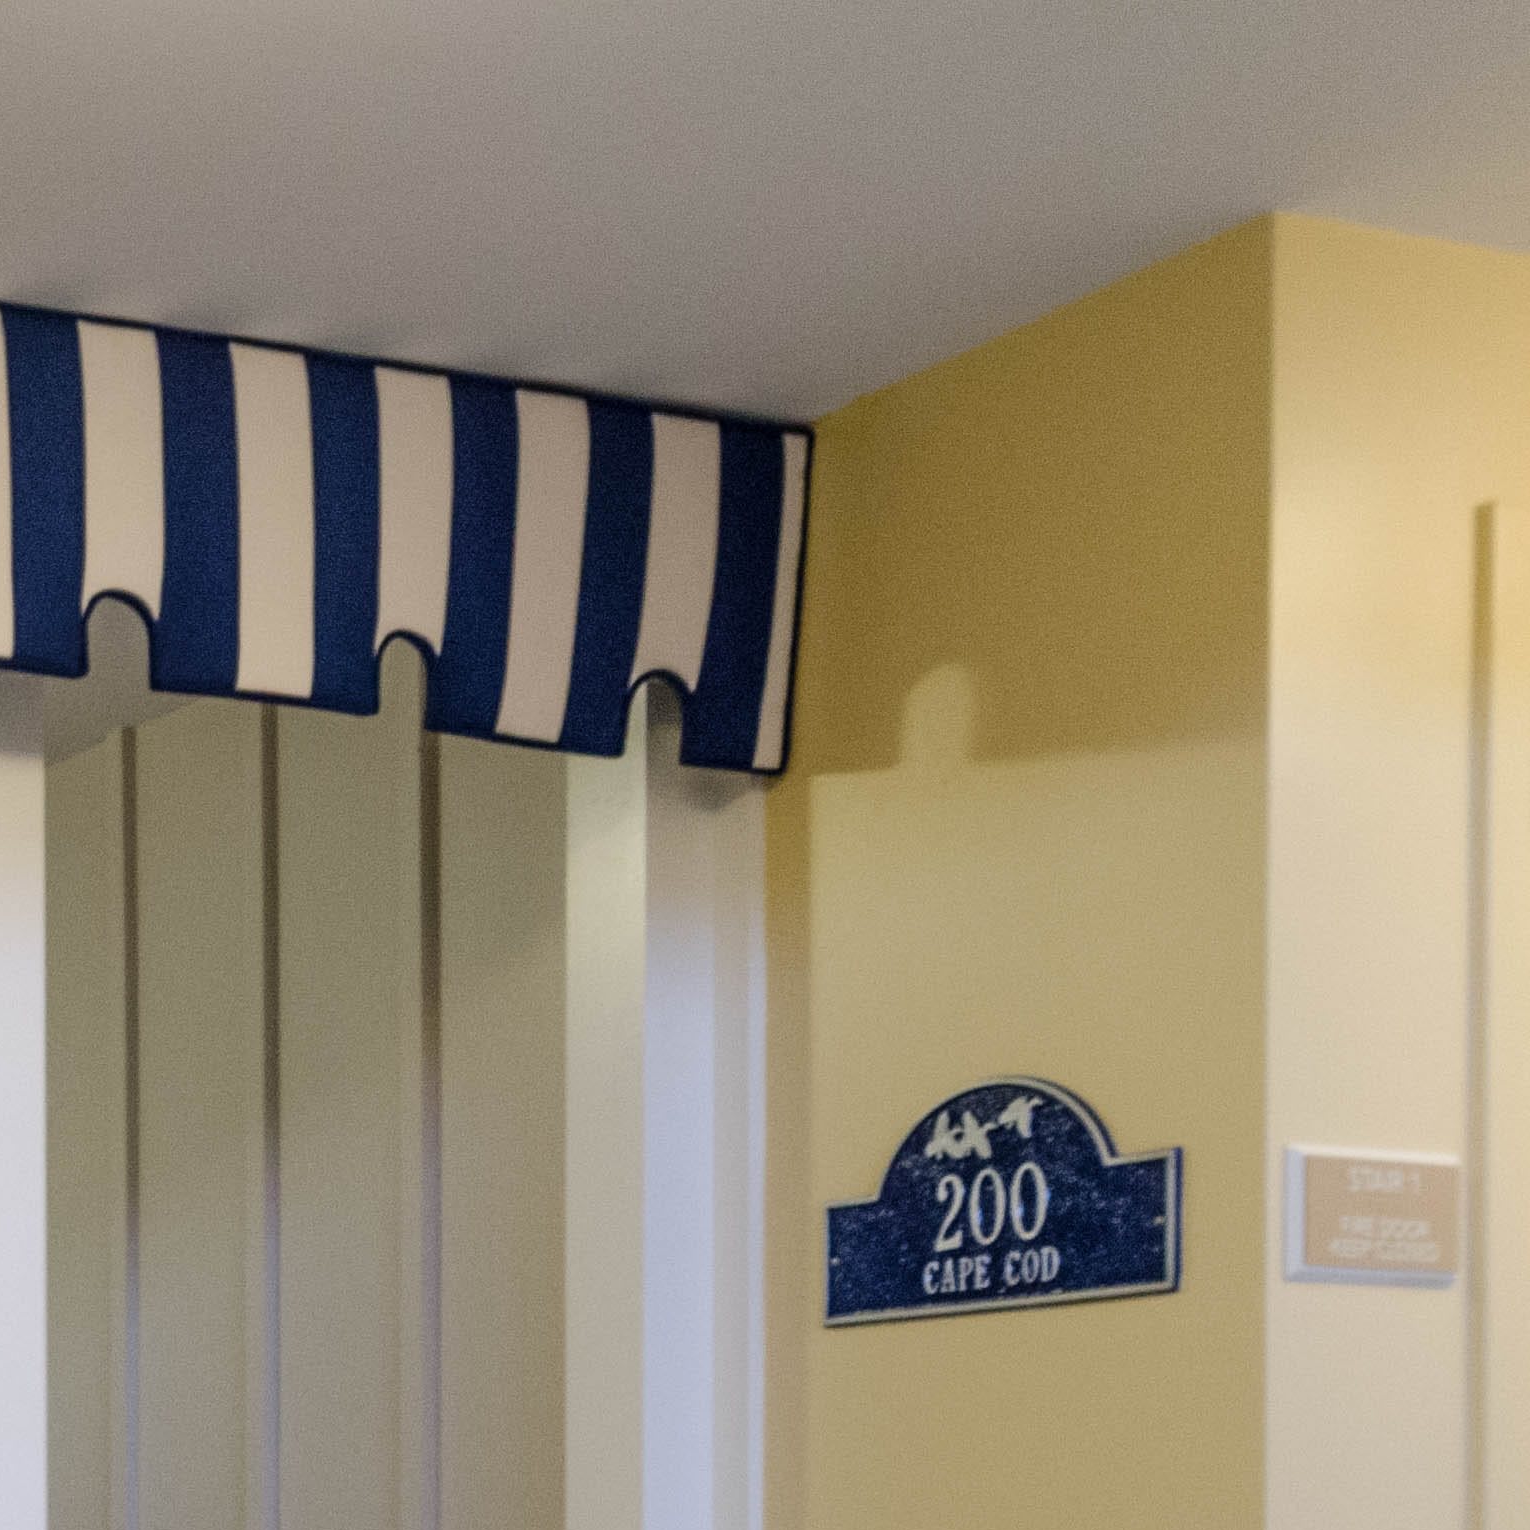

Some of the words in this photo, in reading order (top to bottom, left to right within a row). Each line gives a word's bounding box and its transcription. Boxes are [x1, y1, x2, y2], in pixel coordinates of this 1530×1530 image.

[934, 1161, 1050, 1252] 200
[924, 1255, 991, 1295] CAPE
[1003, 1246, 1061, 1287] COD
